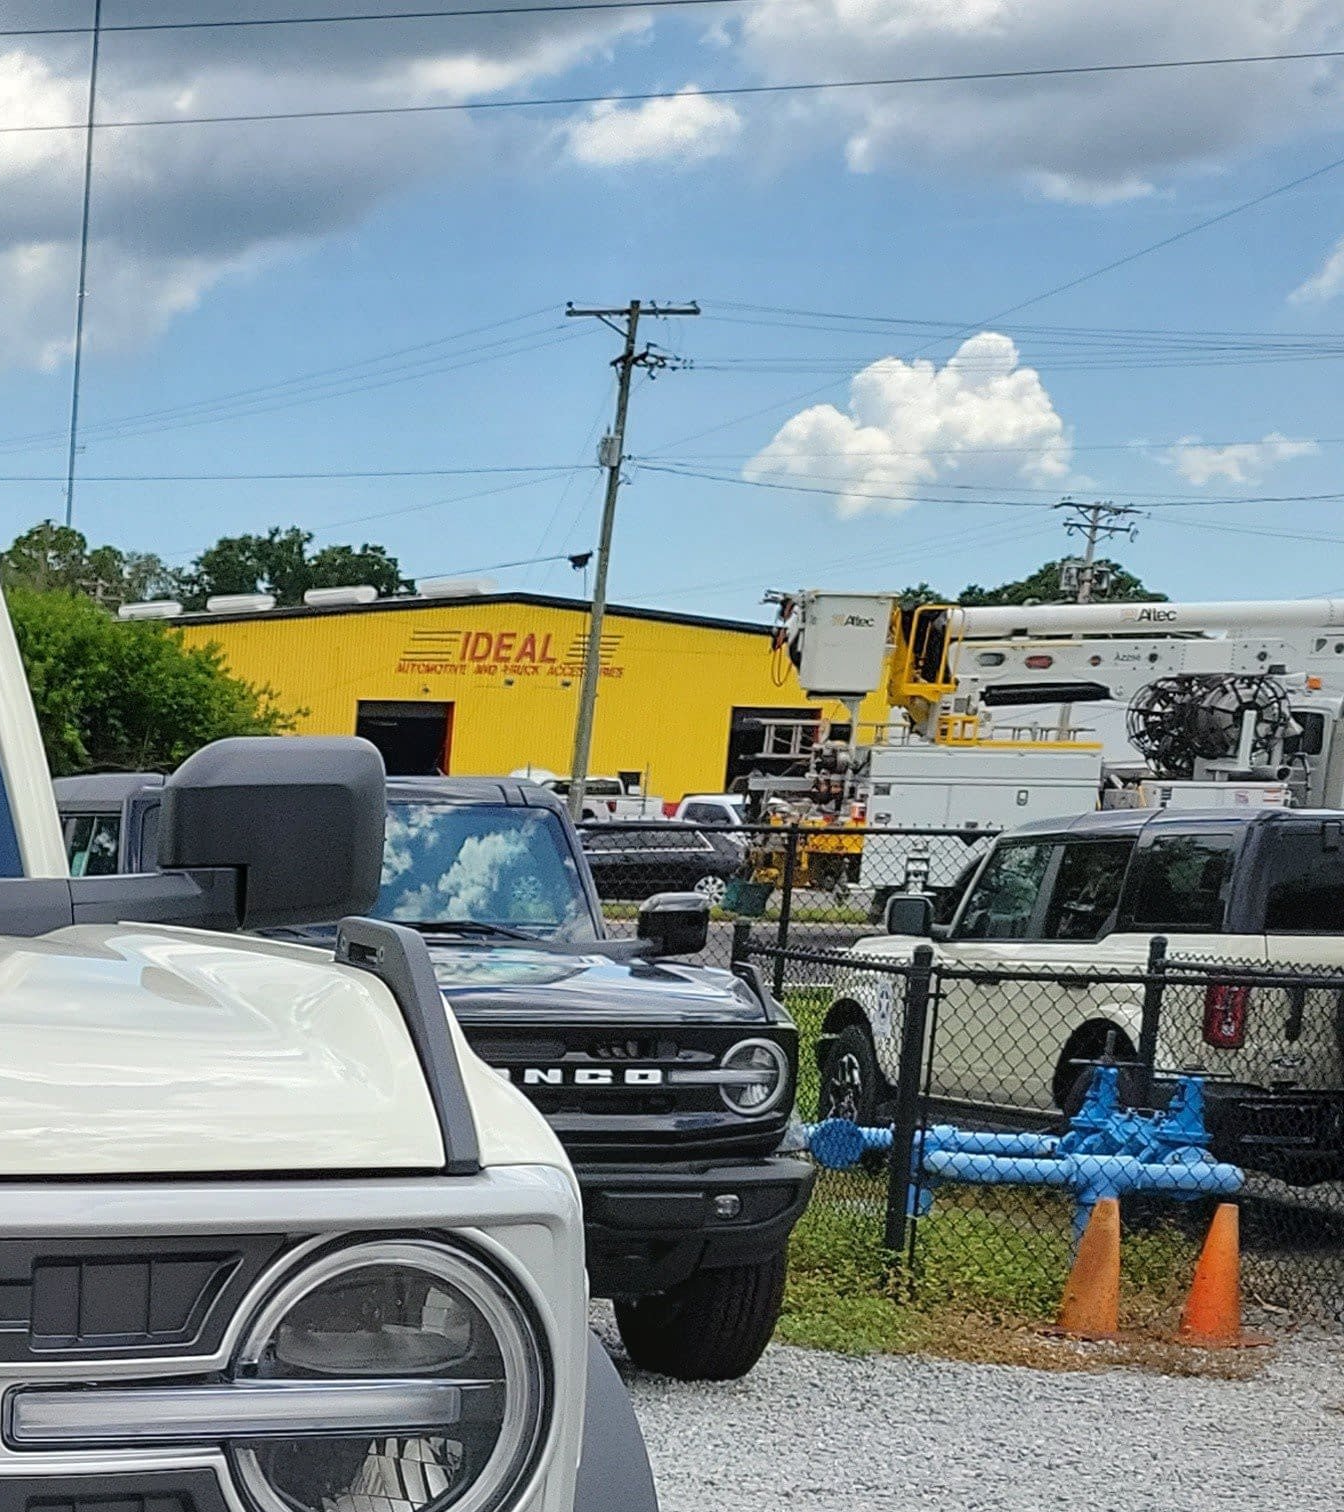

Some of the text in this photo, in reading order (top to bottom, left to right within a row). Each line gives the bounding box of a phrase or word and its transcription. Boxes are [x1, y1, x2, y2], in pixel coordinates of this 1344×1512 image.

[844, 614, 874, 628] Altec
[1137, 607, 1177, 622] Altec
[459, 631, 558, 663] IDEAL
